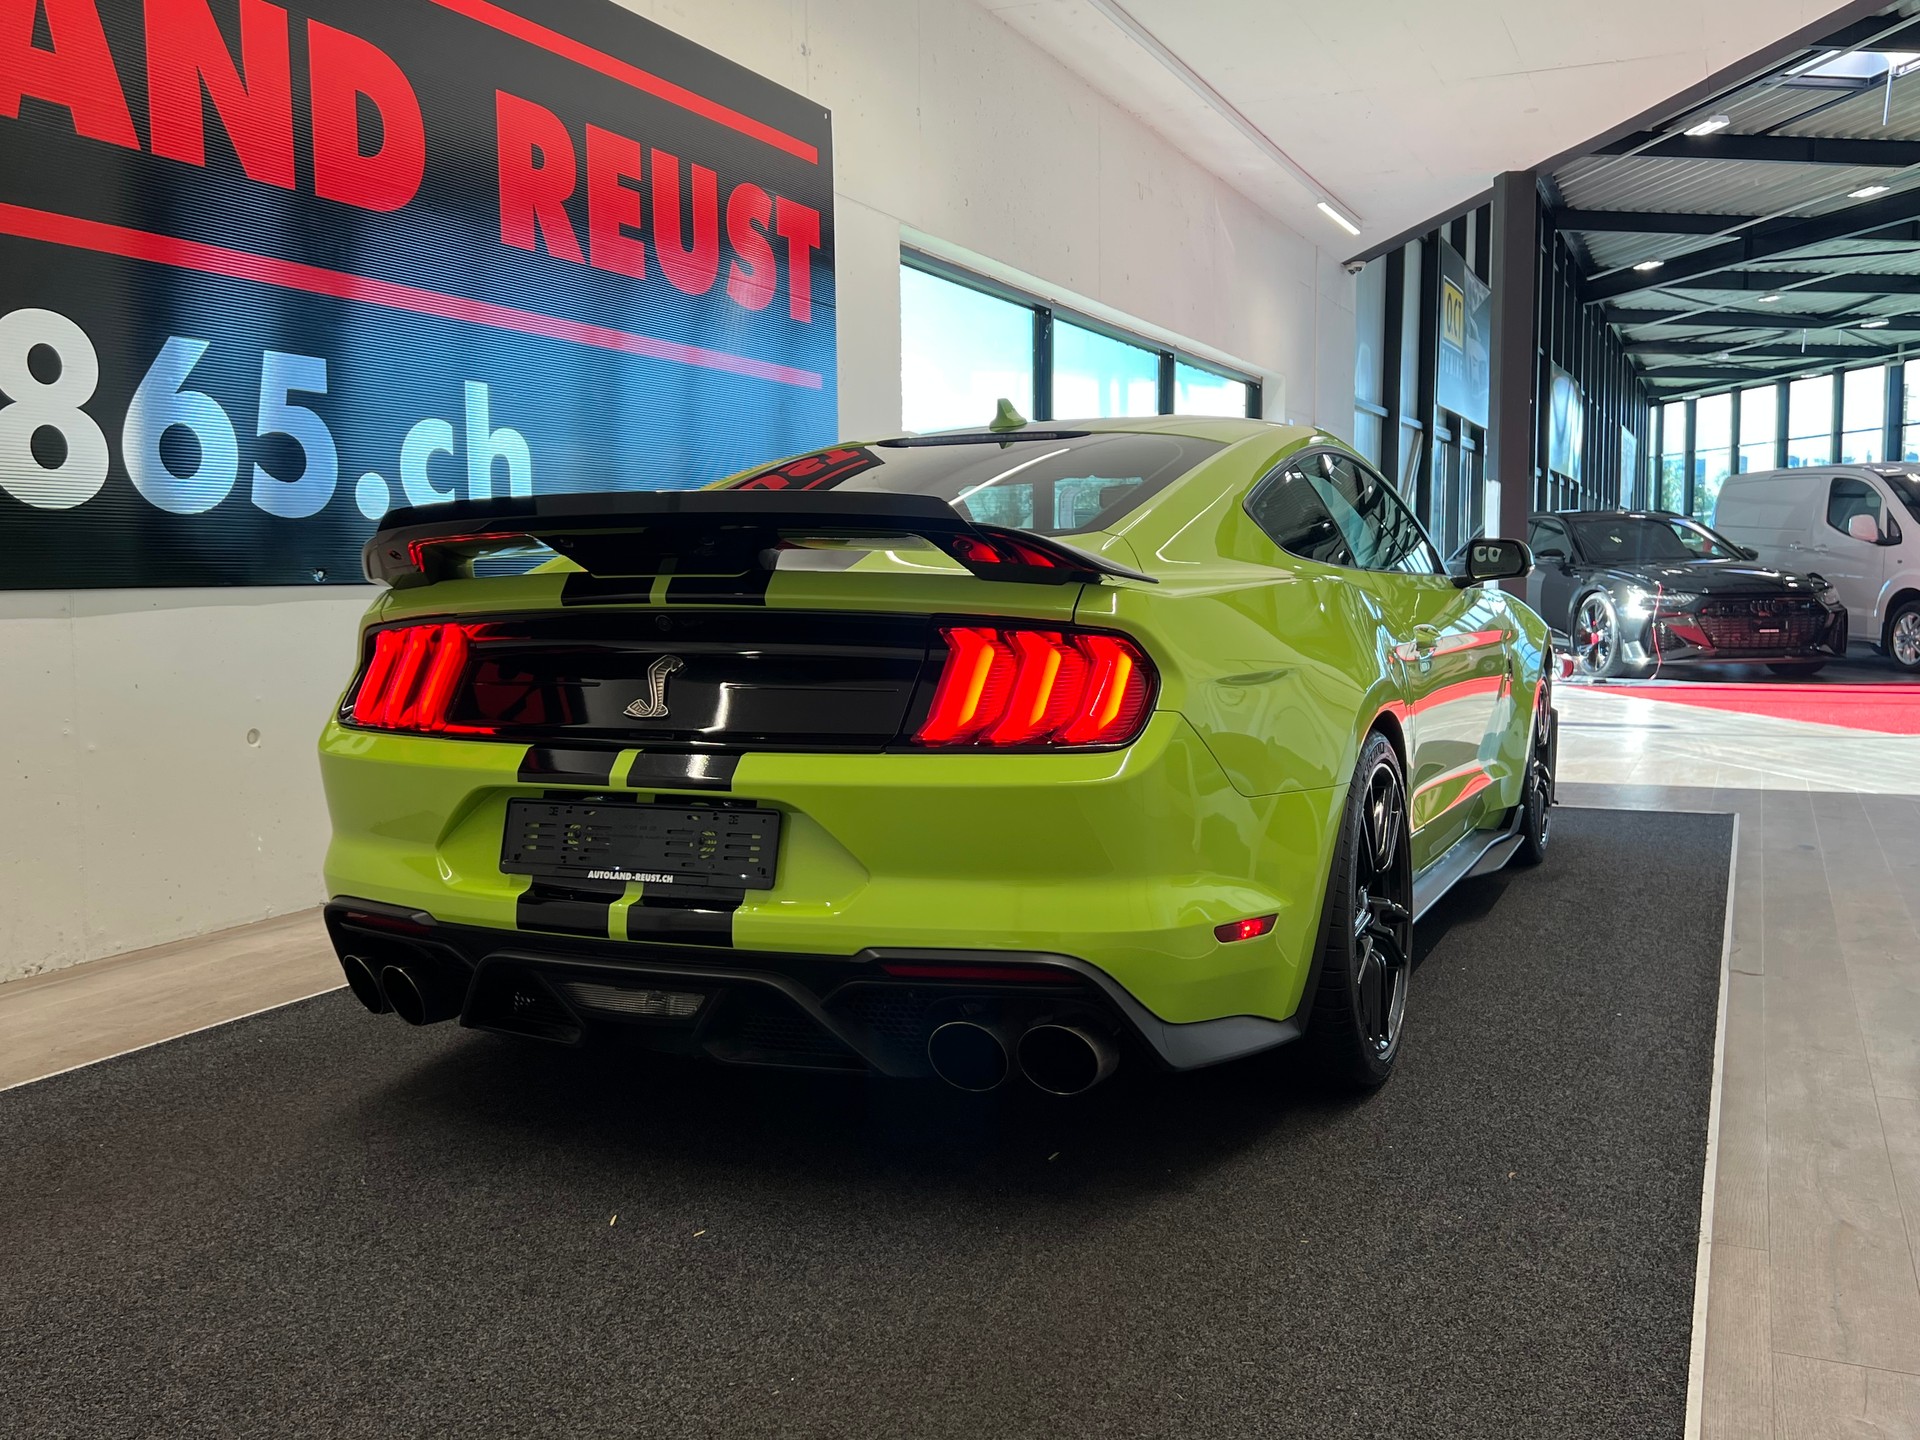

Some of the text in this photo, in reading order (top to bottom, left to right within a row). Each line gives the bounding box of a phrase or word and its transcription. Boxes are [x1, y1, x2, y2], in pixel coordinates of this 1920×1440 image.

[0, 0, 821, 324] AND REUST
[0, 307, 532, 520] 865.ch
[587, 870, 674, 883] AUTOLAND-REUST.CH
